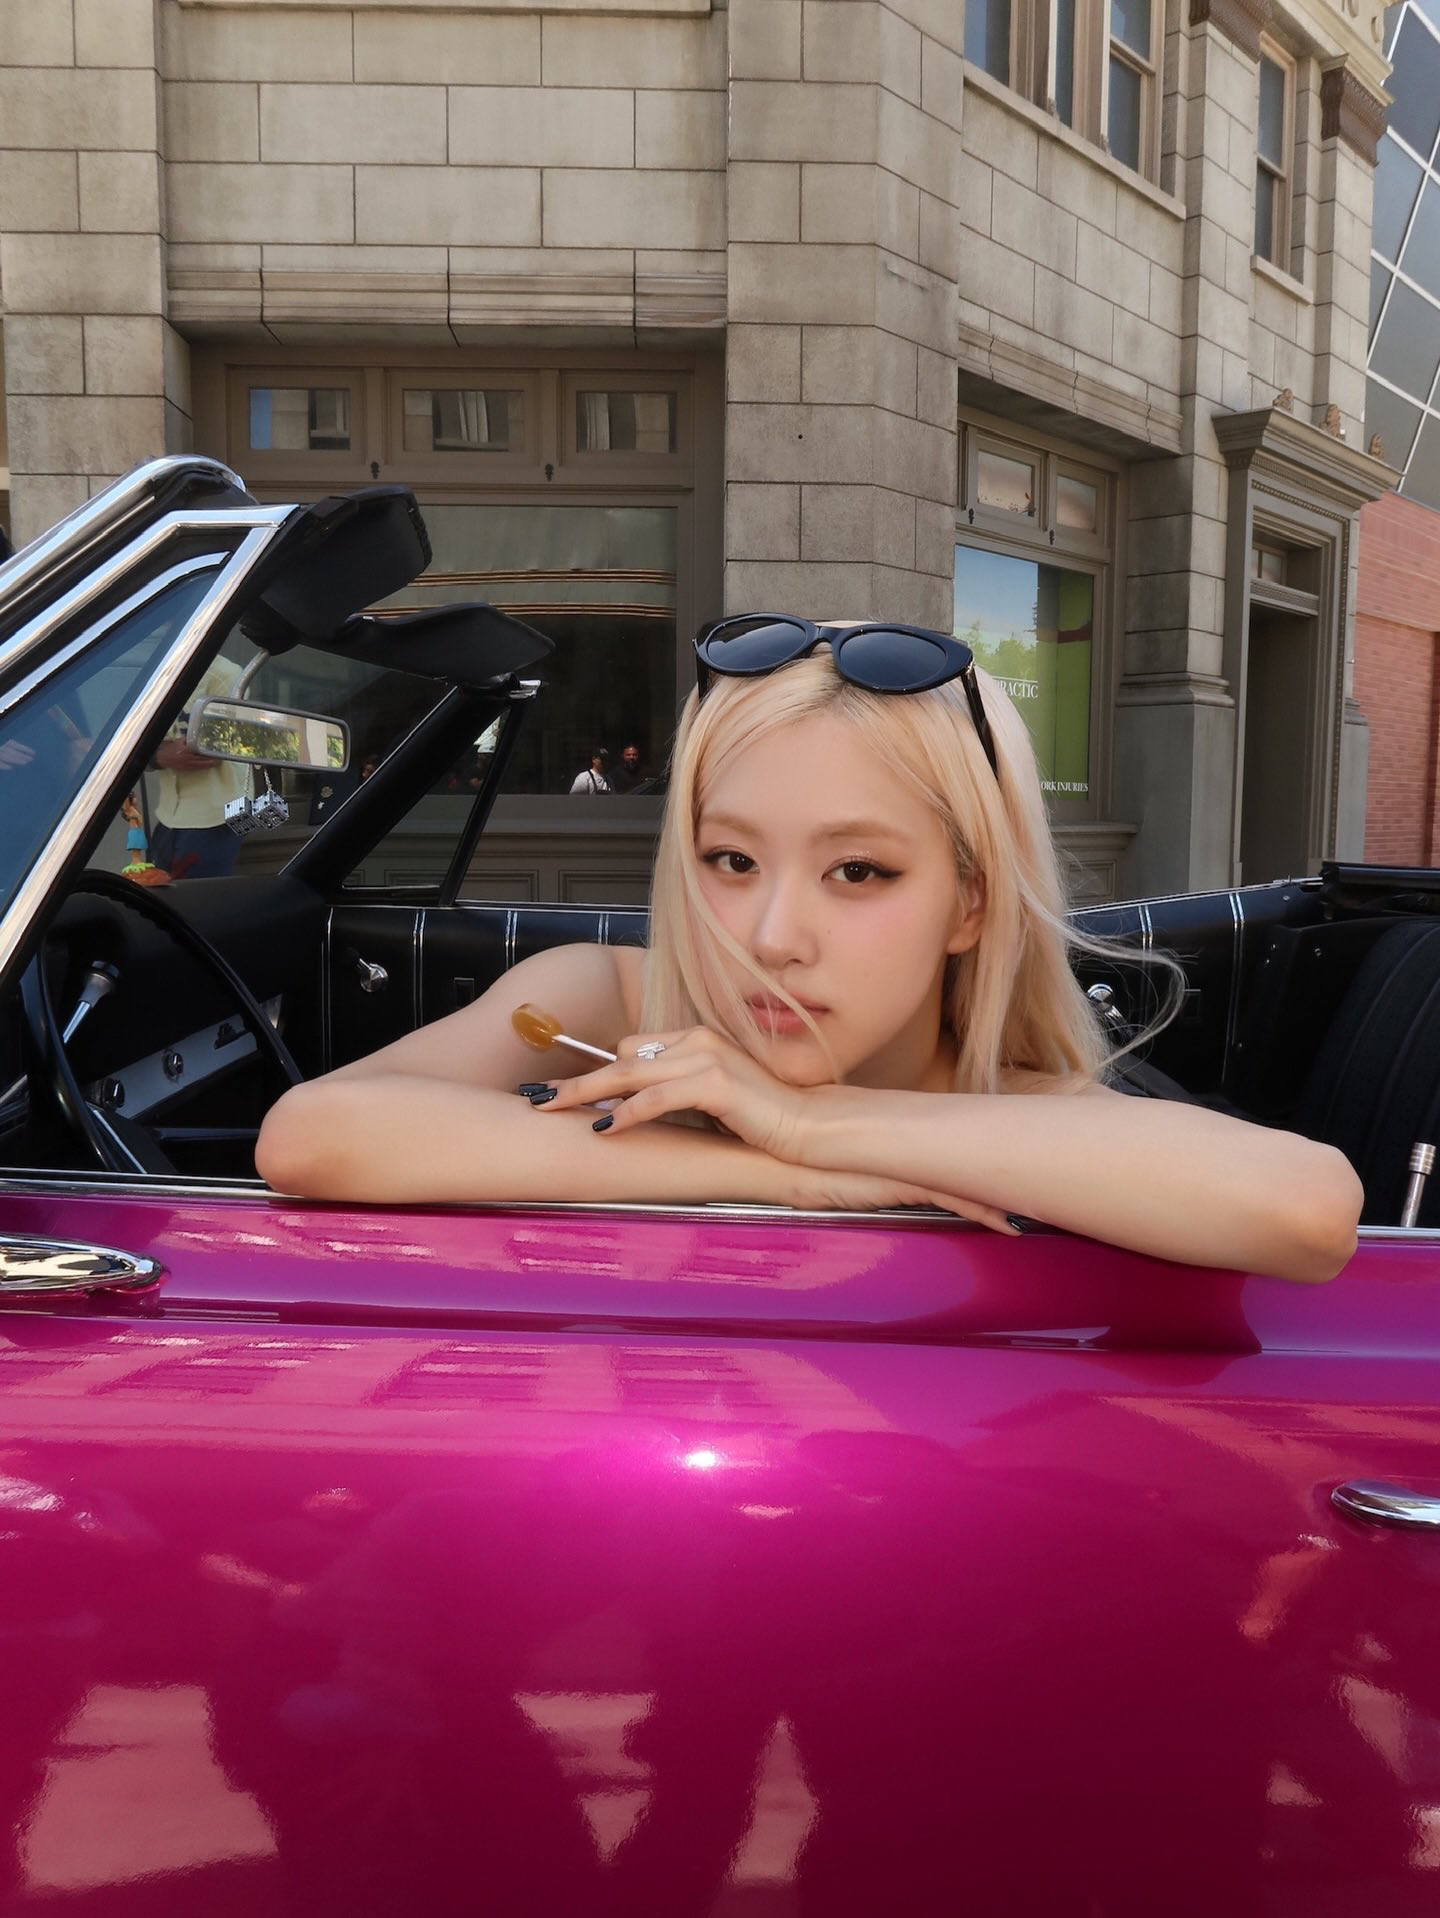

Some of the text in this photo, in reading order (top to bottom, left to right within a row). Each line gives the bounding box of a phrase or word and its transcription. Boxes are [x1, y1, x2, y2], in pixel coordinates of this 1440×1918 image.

[996, 680, 1039, 698] RACTIC
[1040, 780, 1089, 792] ORK INJURIES
